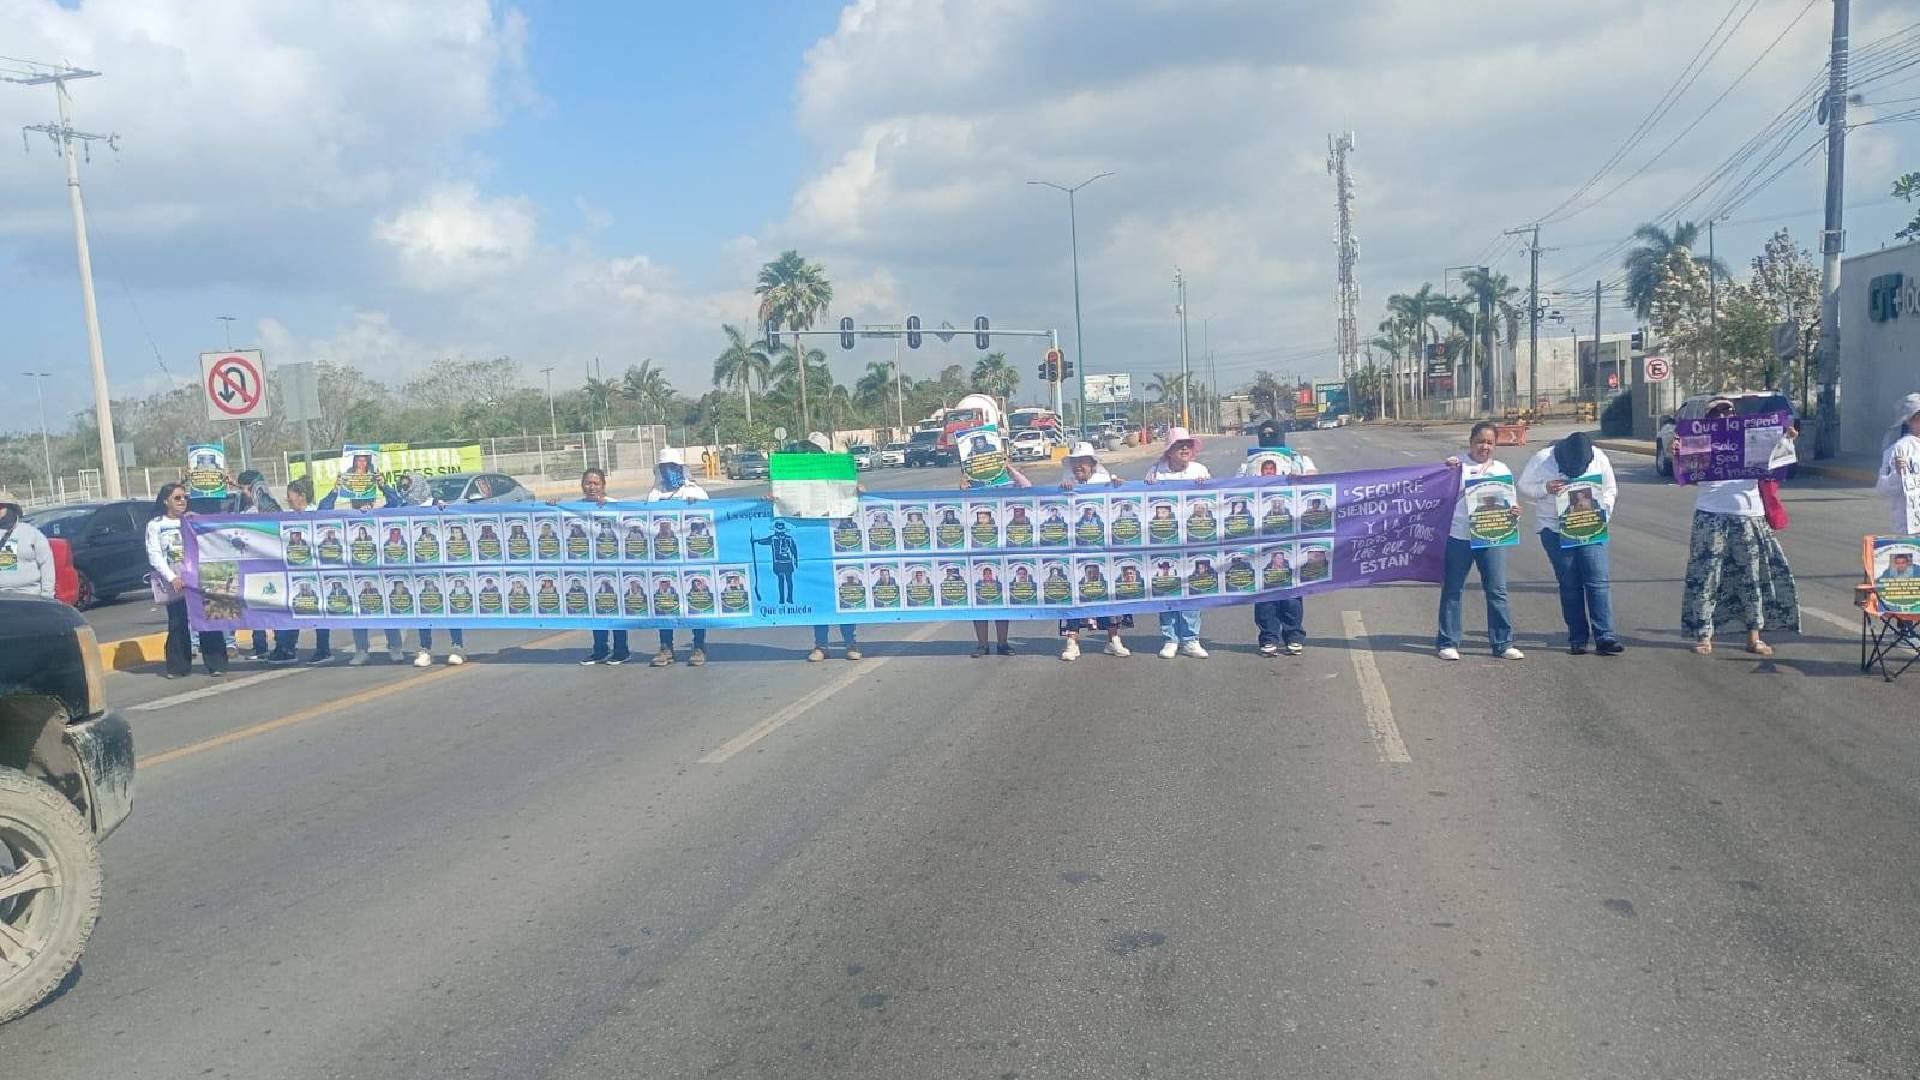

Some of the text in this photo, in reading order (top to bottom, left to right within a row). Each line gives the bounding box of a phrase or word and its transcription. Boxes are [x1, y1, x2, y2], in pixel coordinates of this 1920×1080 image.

[1692, 421, 1718, 434] Que
[1726, 419, 1739, 431] la
[1337, 500, 1388, 518] SIENDO
[1392, 498, 1412, 515] TU
[1363, 521, 1376, 535] Y
[1382, 539, 1407, 555] QUE
[760, 606, 776, 617] Que
